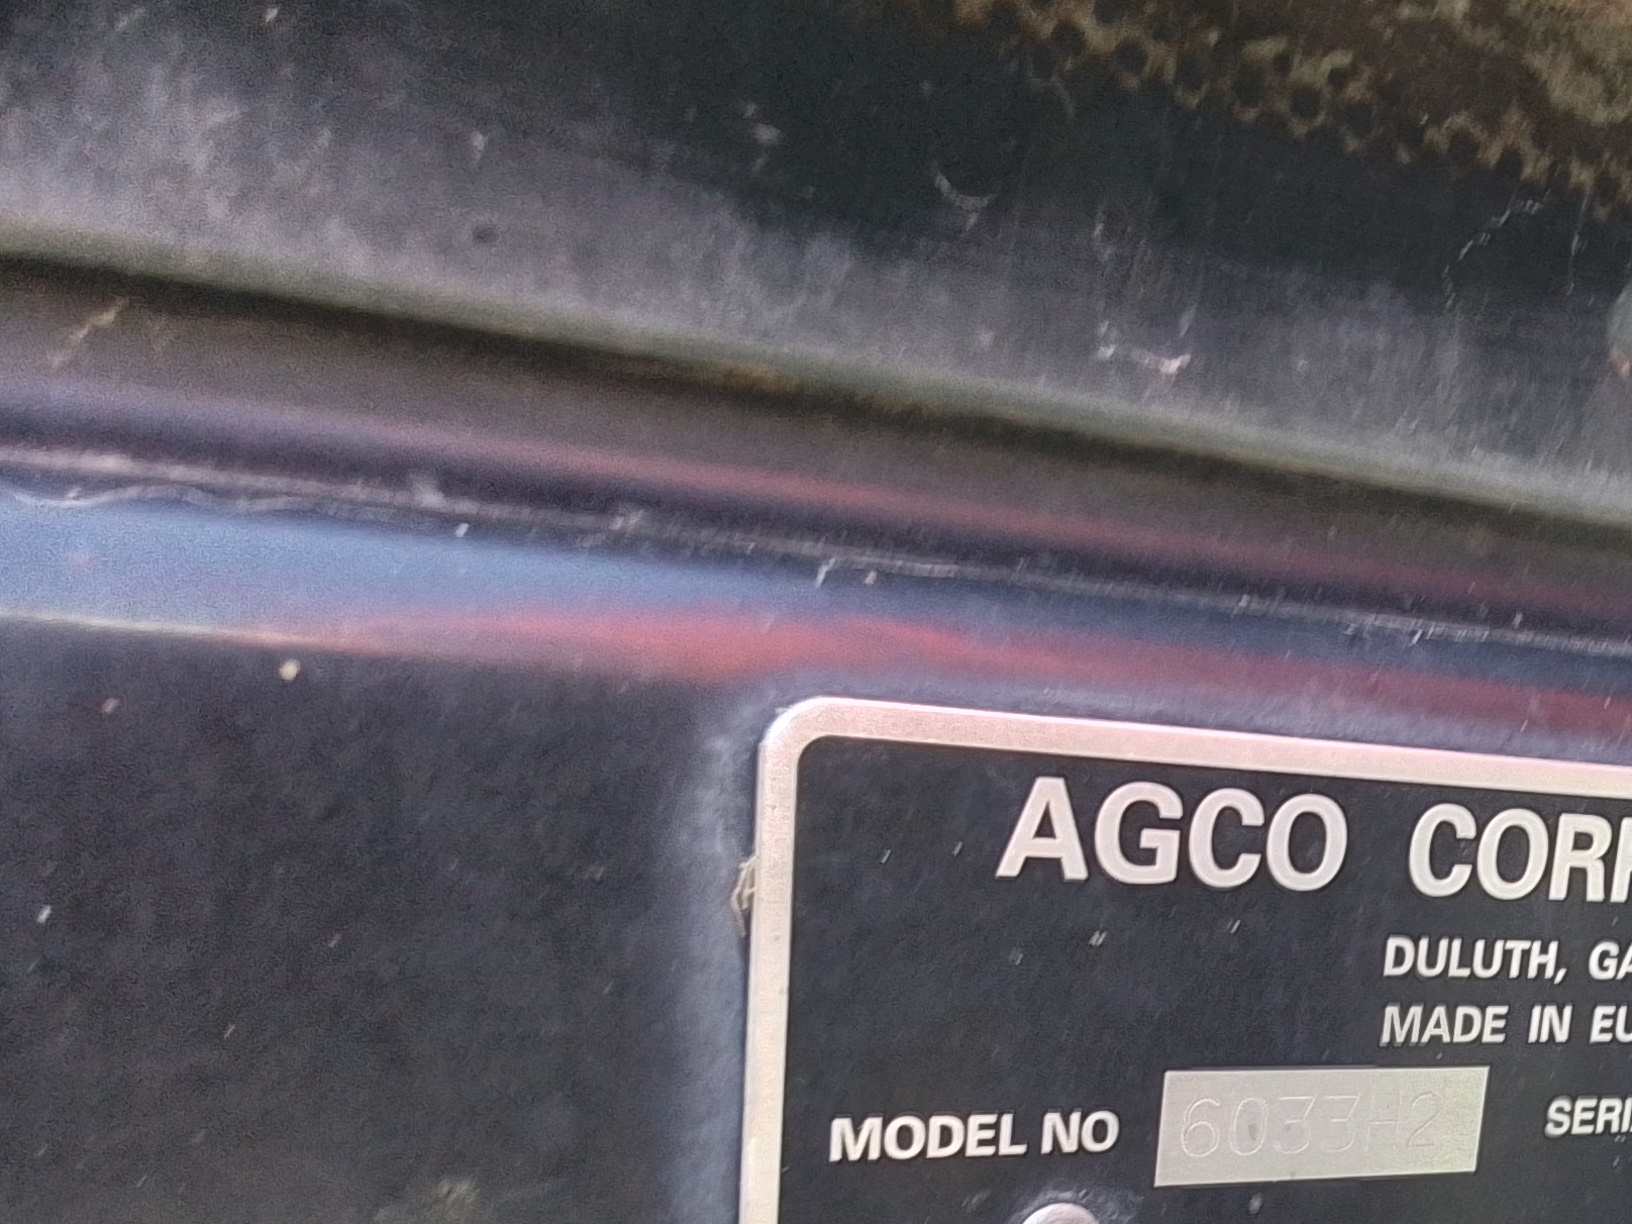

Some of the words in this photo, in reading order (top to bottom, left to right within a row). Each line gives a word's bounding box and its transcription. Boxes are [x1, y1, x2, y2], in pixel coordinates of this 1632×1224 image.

[996, 777, 1348, 891] AGCO
[1384, 936, 1567, 984] DULUTH,
[1380, 1005, 1508, 1046] MADE
[1528, 1005, 1572, 1043] IN
[829, 1113, 1027, 1162] MODEL
[1041, 1110, 1119, 1153] NO
